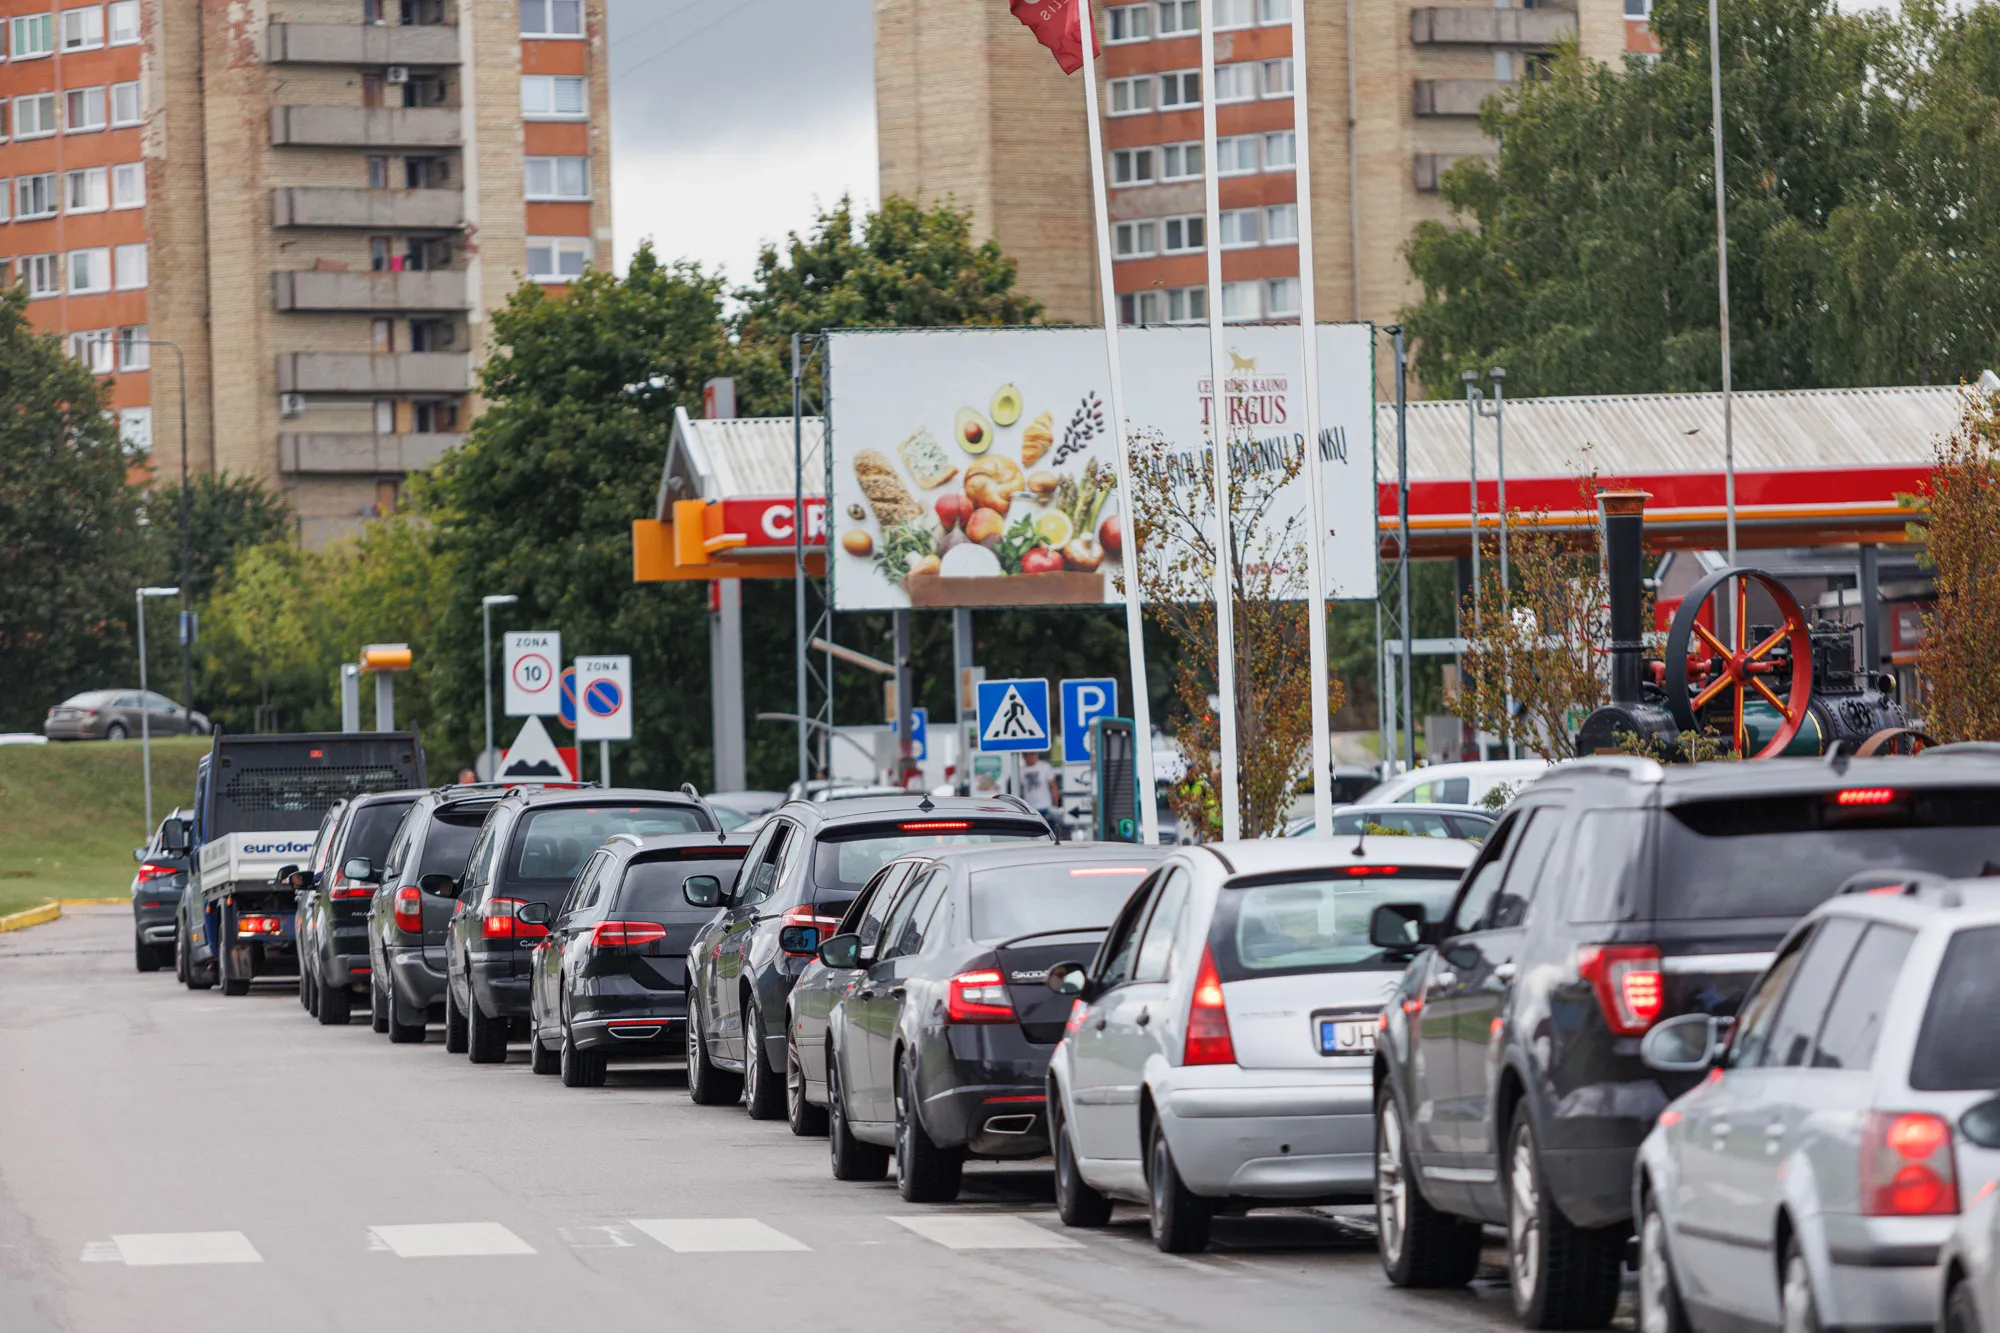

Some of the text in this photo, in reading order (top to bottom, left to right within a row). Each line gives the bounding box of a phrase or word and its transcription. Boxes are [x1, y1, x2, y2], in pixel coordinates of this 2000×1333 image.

[1252, 377, 1288, 392] KAUNO
[1199, 394, 1287, 425] TRGUS
[1294, 426, 1347, 466] RNKŲ
[515, 637, 549, 647] ZONA
[523, 665, 542, 682] 10
[585, 661, 619, 672] ZONA
[1077, 686, 1106, 728] P
